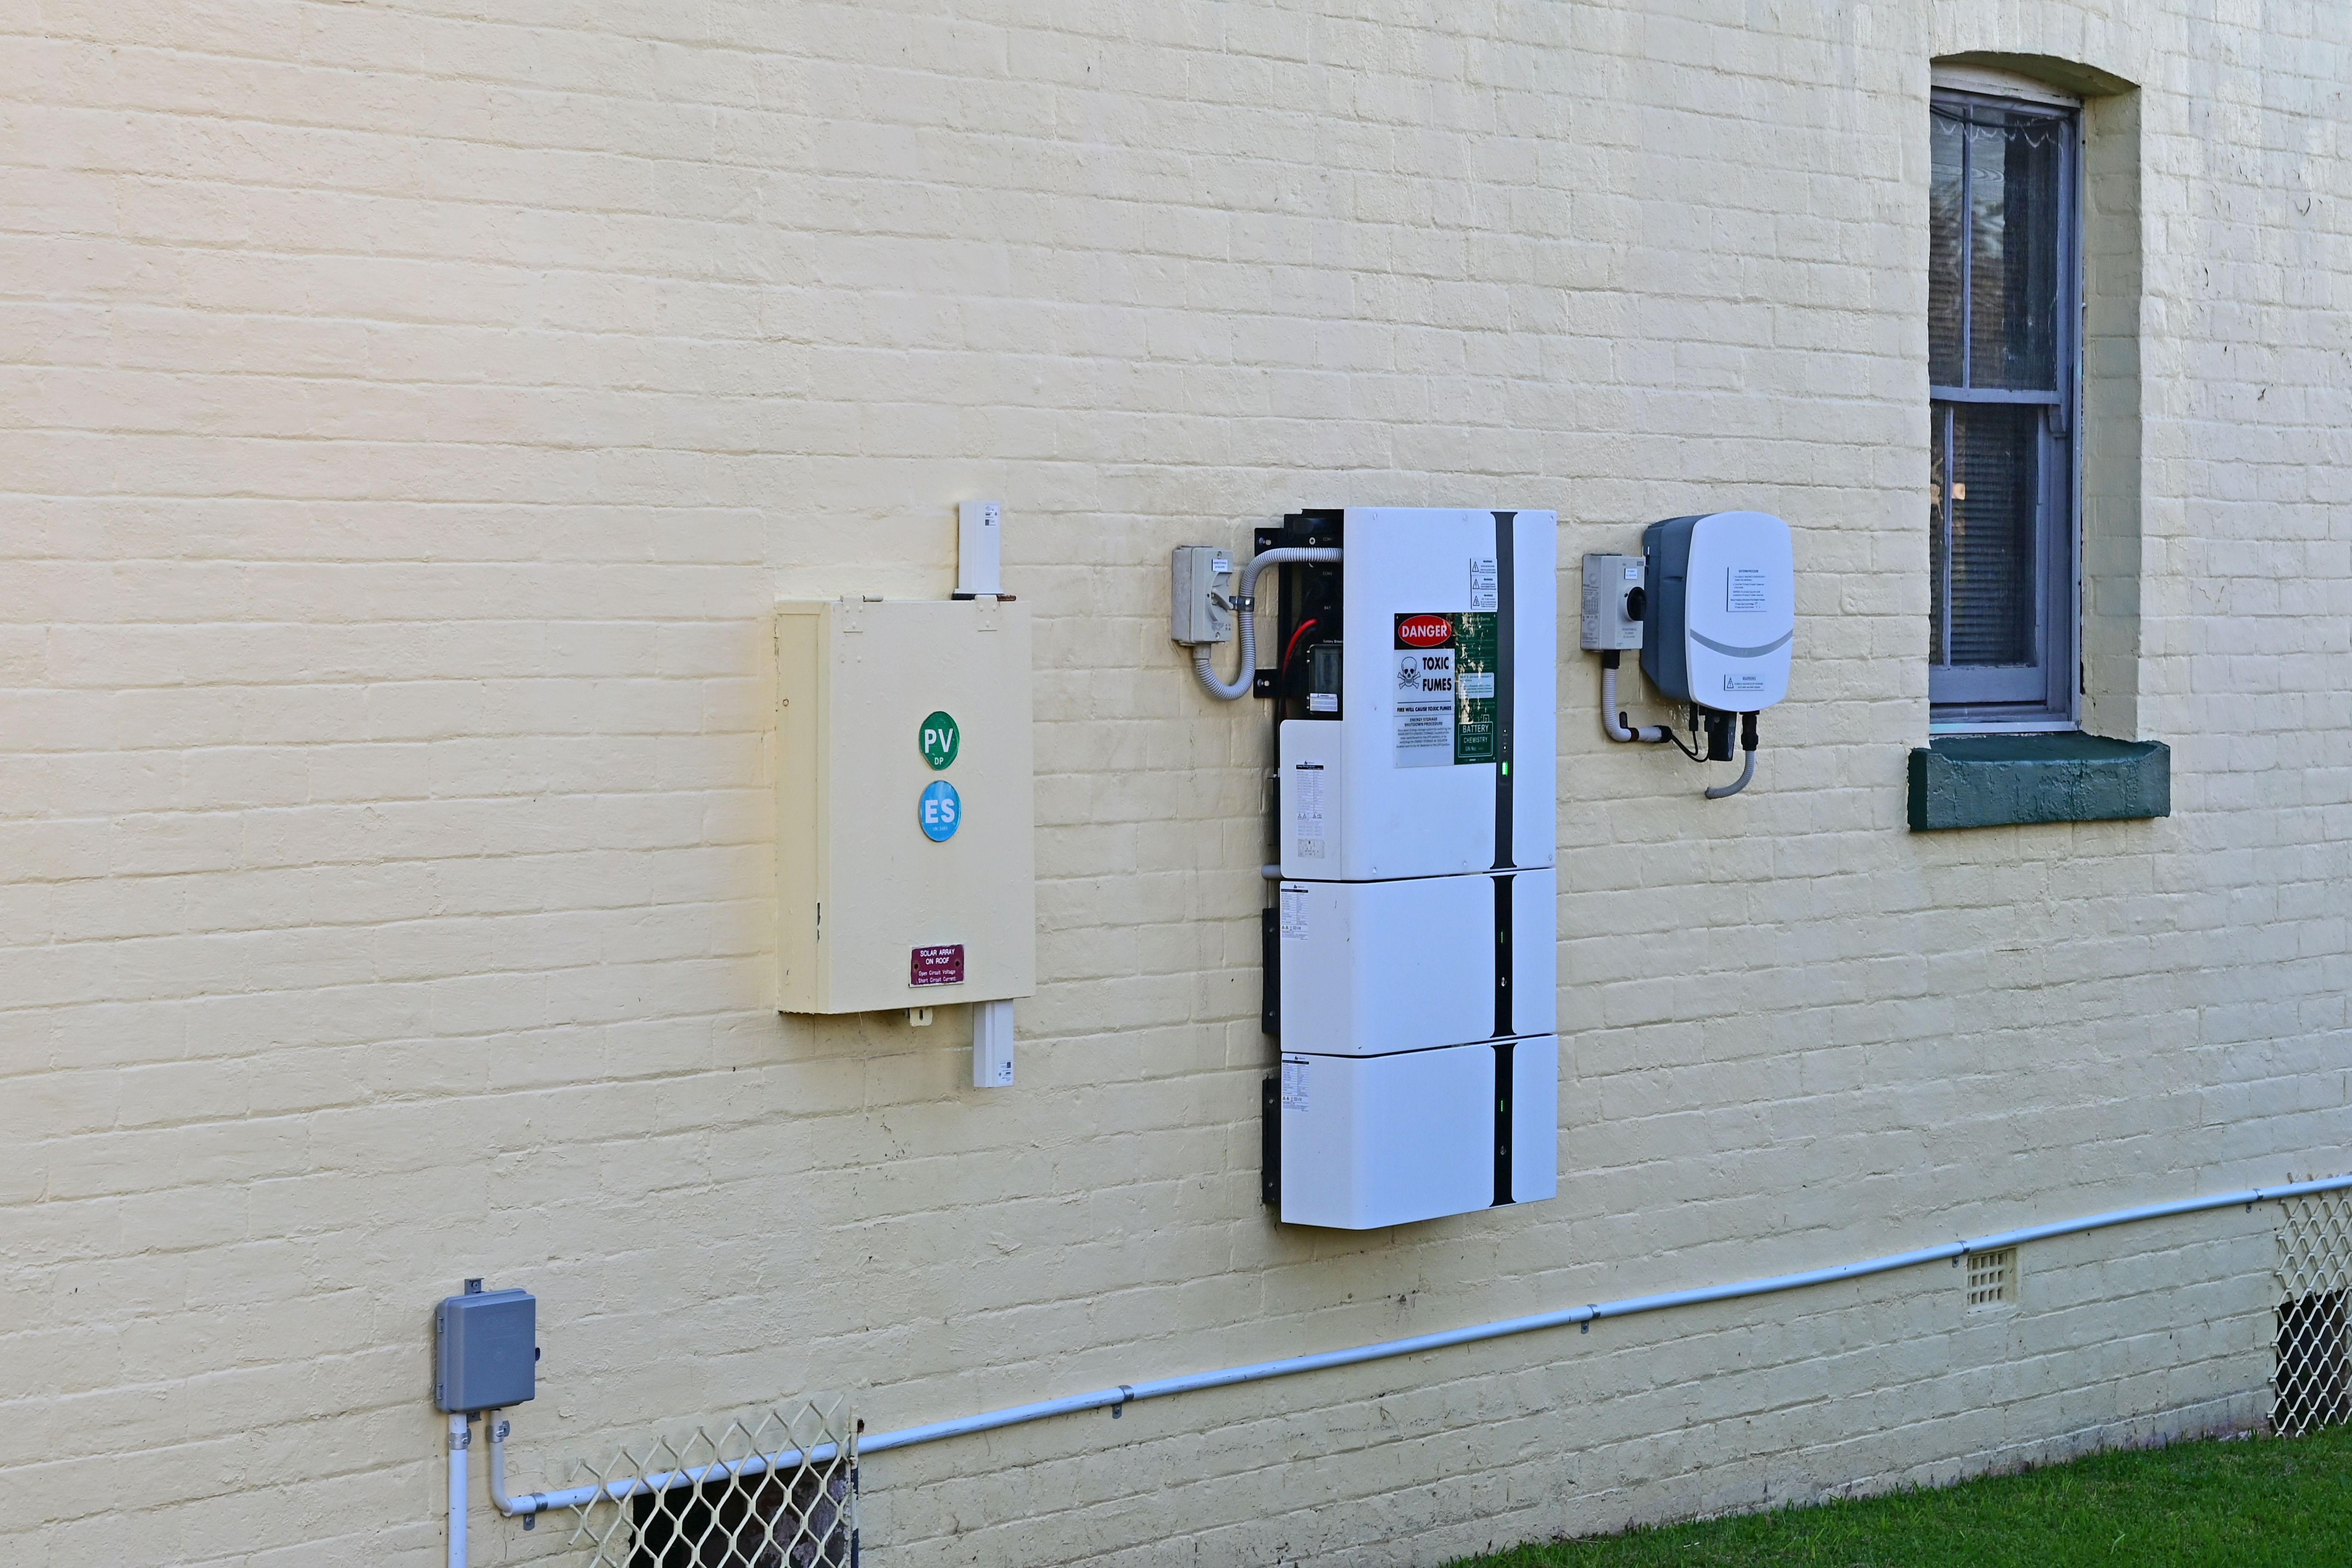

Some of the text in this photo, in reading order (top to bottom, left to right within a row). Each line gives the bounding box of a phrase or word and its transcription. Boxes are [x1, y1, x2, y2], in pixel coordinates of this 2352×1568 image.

[1402, 625, 1447, 637] DANGER
[1422, 656, 1449, 670] TOXIC
[1423, 678, 1452, 691] FUMES
[1462, 724, 1489, 733] BATTERY
[925, 728, 953, 753] PV
[934, 757, 944, 765] DP
[925, 798, 955, 824] ES
